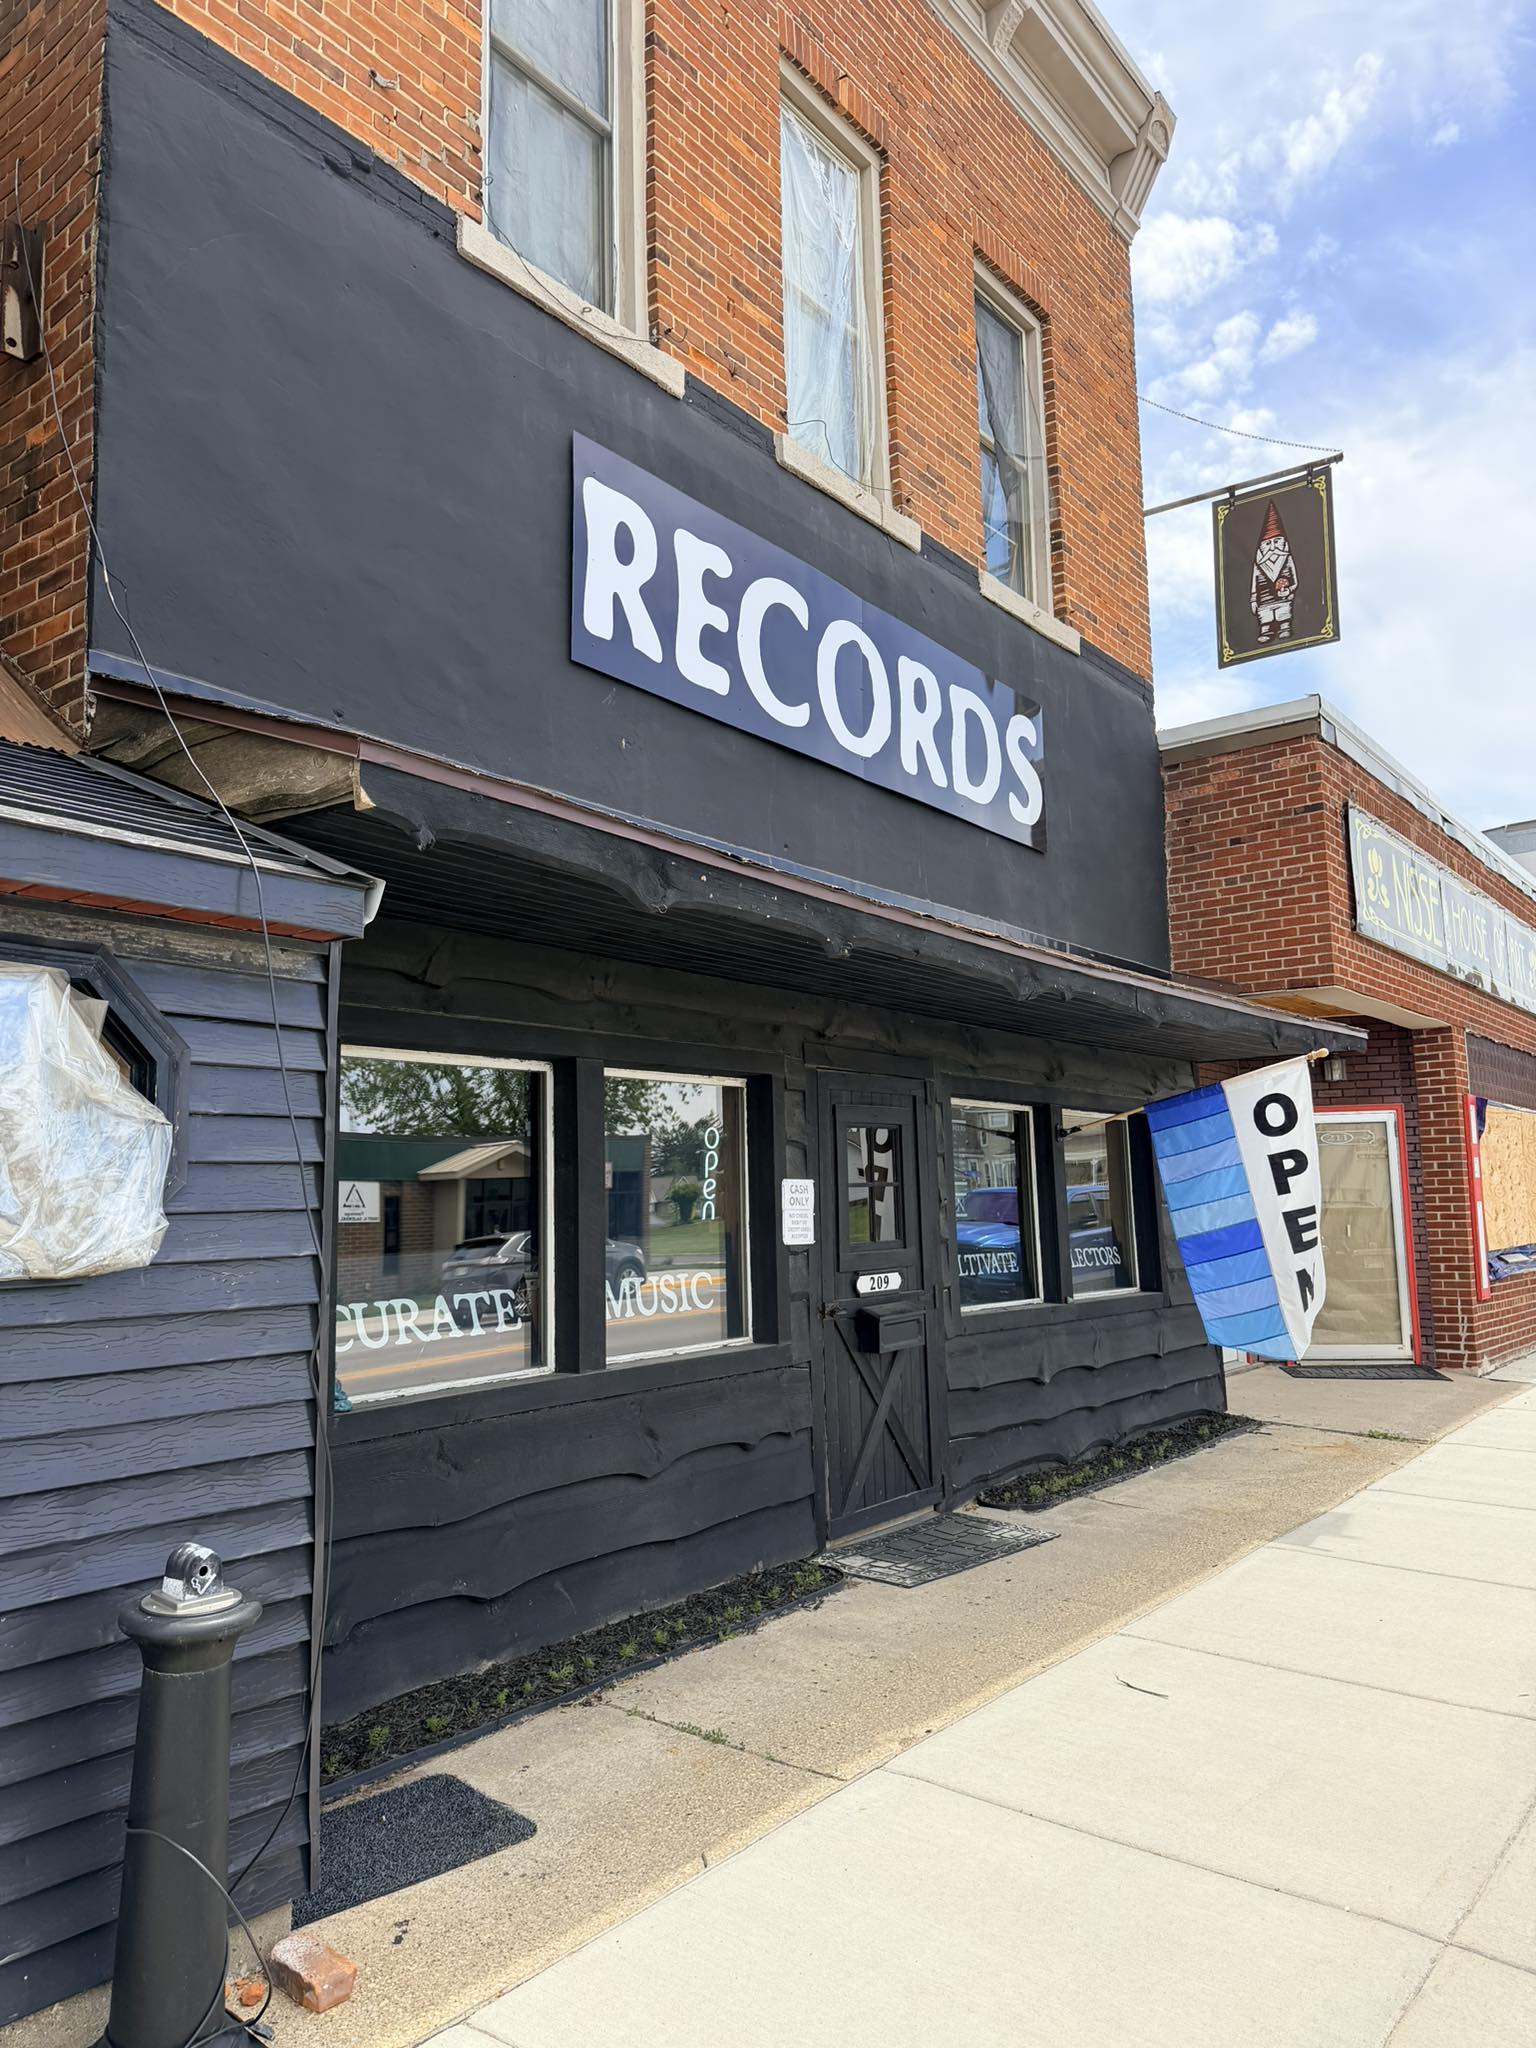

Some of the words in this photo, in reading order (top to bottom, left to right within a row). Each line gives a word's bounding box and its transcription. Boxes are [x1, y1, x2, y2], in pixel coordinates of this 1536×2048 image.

[582, 476, 1043, 825] RECORDS
[1391, 853, 1443, 948] NISSE
[1451, 898, 1490, 963] HOUSE
[1493, 926, 1506, 969] OF
[789, 1196, 809, 1207] ONLY
[790, 1184, 809, 1195] CASH
[1253, 1092, 1318, 1313] OPEN
[605, 1271, 714, 1320] MUSIC
[869, 1275, 890, 1291] 209
